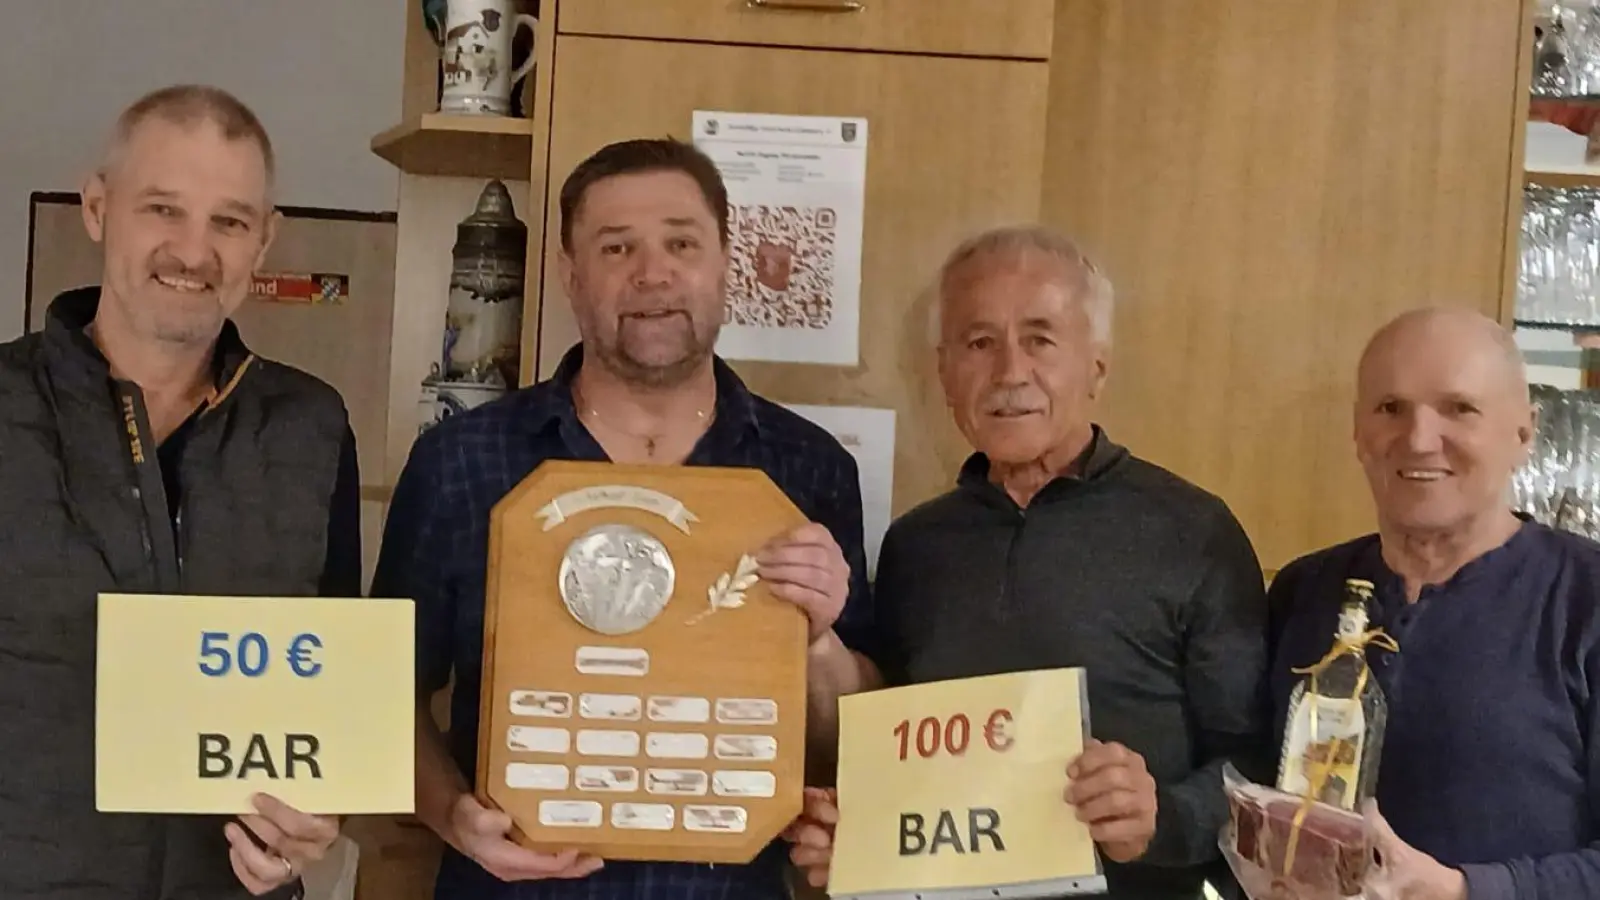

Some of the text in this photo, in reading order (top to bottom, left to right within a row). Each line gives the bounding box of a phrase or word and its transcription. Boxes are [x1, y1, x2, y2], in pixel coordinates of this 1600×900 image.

[198, 631, 323, 678] 50 €
[197, 732, 323, 779] BAR
[893, 708, 1015, 762] 100 €
[898, 807, 1006, 856] BAR
